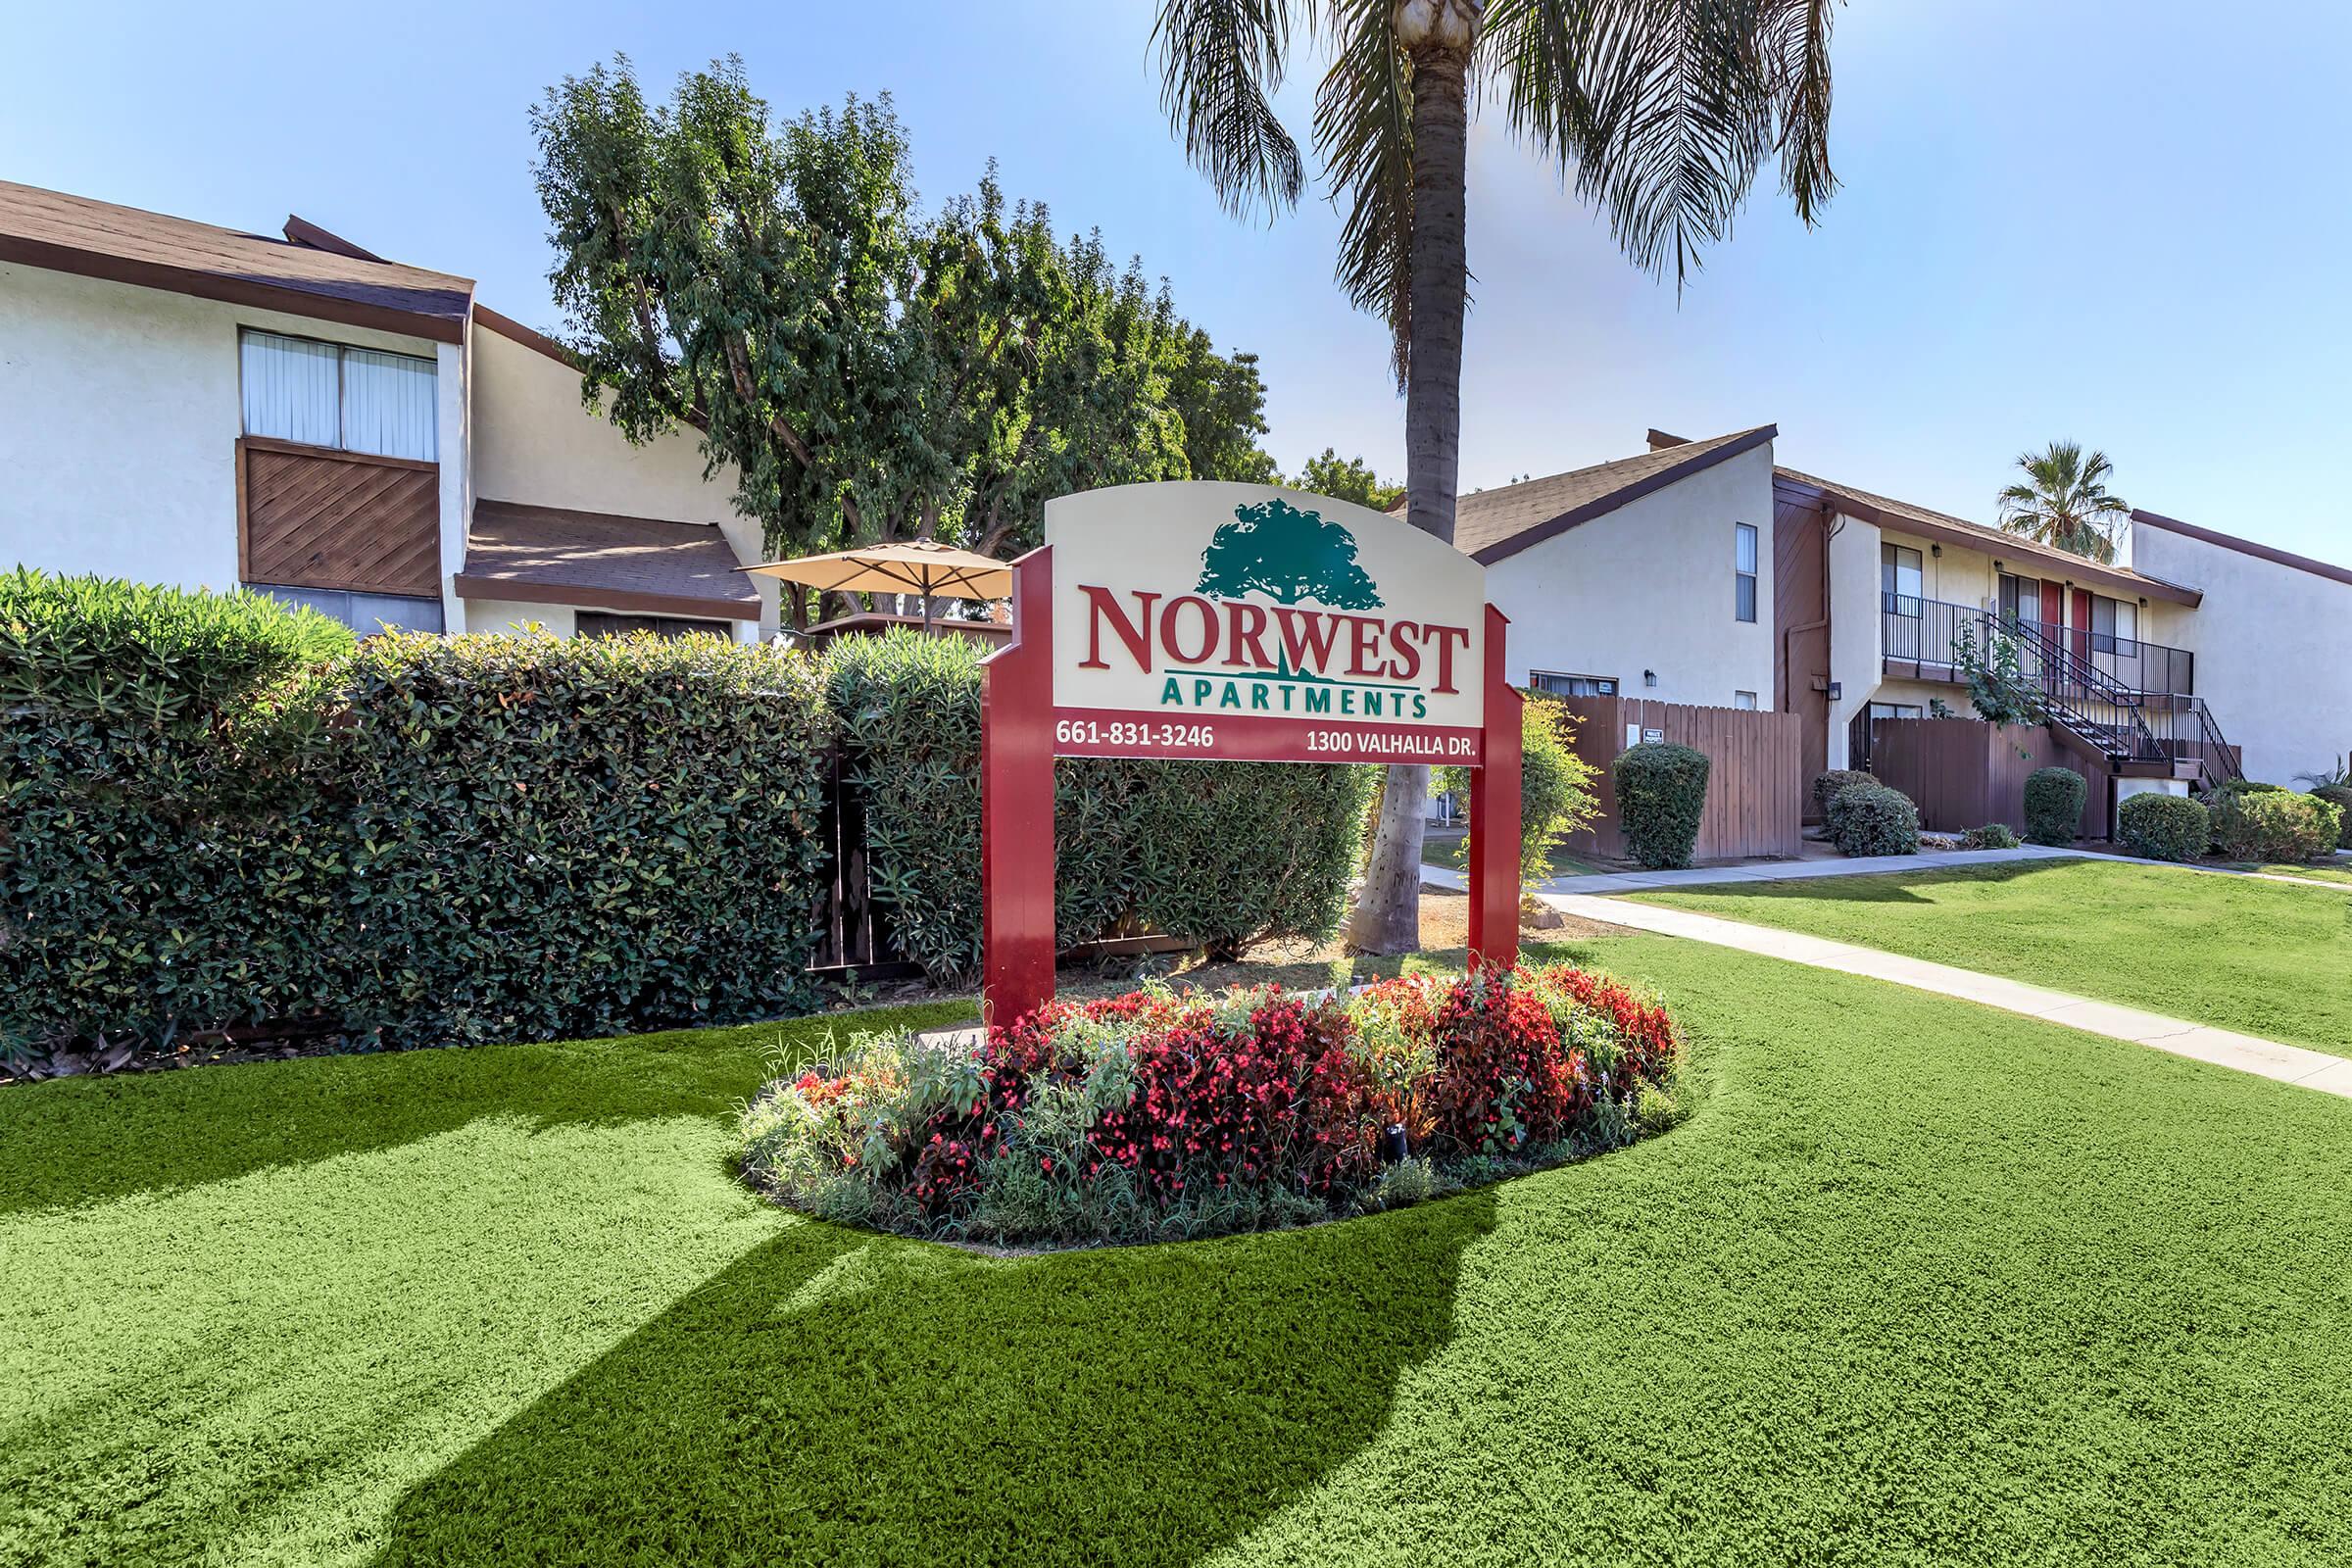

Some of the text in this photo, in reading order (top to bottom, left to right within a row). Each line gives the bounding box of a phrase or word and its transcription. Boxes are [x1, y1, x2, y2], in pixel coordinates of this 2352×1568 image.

[1078, 584, 1469, 695] NORWEST
[1161, 677, 1427, 718] APARTMENTS
[1055, 720, 1214, 747] 661-831-3246
[1306, 731, 1476, 756] 1300 VALHALLA DR.
